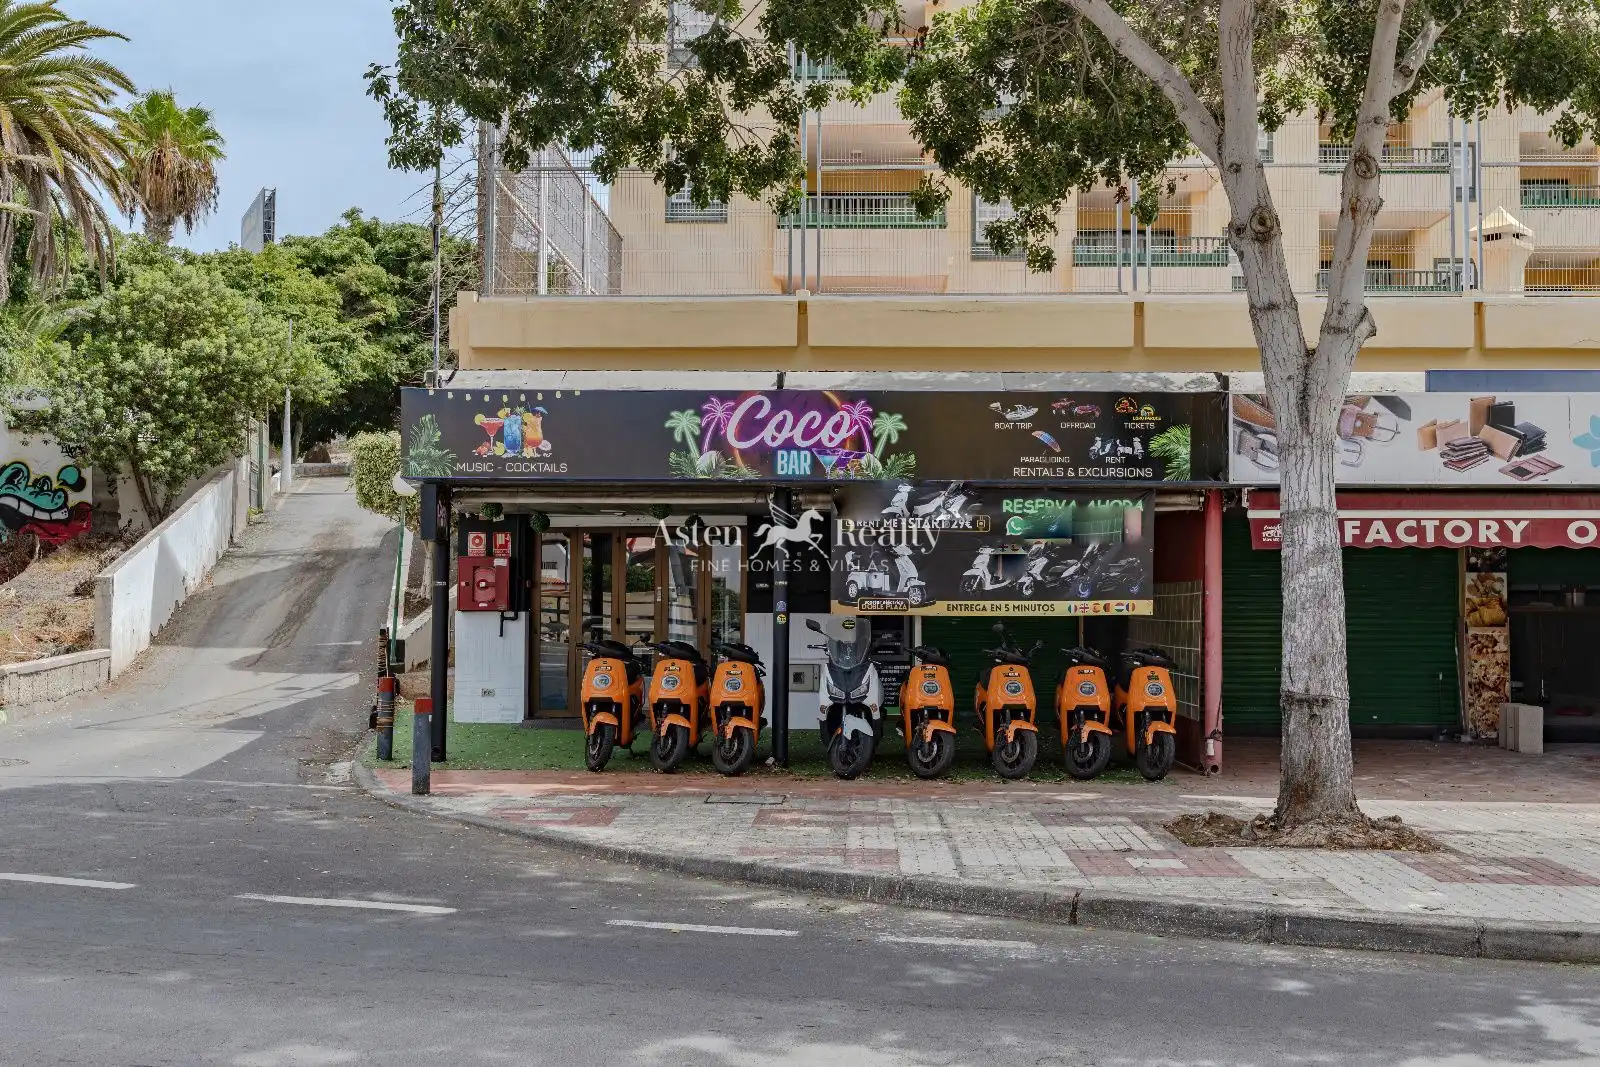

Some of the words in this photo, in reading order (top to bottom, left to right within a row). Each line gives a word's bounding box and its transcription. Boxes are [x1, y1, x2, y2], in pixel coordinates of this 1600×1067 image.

[726, 395, 859, 449] Coco
[994, 422, 1014, 430] BOAT
[1016, 422, 1033, 430] TRIP
[1060, 422, 1096, 430] OFFROAD
[1124, 422, 1156, 430] TICKETS
[777, 450, 811, 475] BAR
[1105, 456, 1126, 464] RENT
[456, 462, 494, 473] MUSIC
[505, 462, 568, 473] COCKTAILS
[1013, 468, 1064, 477] RENTALS
[1067, 468, 1075, 477] &
[1078, 468, 1153, 477] EXCURSIONS
[883, 518, 898, 528] ME
[952, 517, 973, 529] 29€
[1344, 519, 1530, 543] FACTORY
[946, 603, 988, 613] ENTREGA
[991, 603, 1002, 613] EN
[1005, 603, 1010, 613] 5
[1013, 603, 1055, 613] MINUTOS
